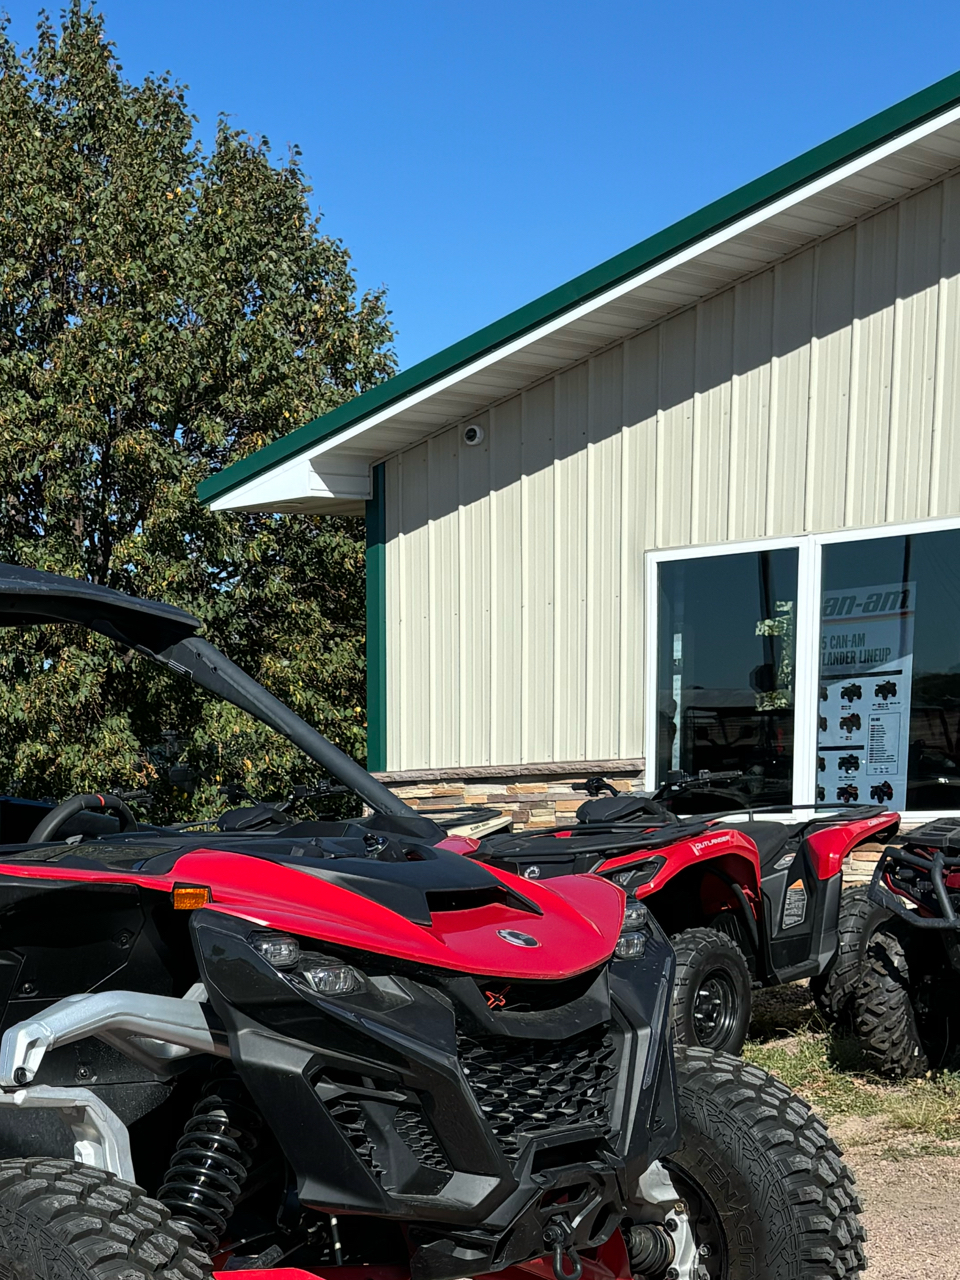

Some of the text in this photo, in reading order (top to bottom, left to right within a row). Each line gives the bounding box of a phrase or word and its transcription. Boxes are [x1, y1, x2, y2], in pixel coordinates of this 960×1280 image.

[822, 589, 910, 616] an-am
[830, 633, 866, 650] CAN-AM
[821, 647, 892, 667] LANDER LINEUP
[695, 835, 730, 850] OUTLANDER
